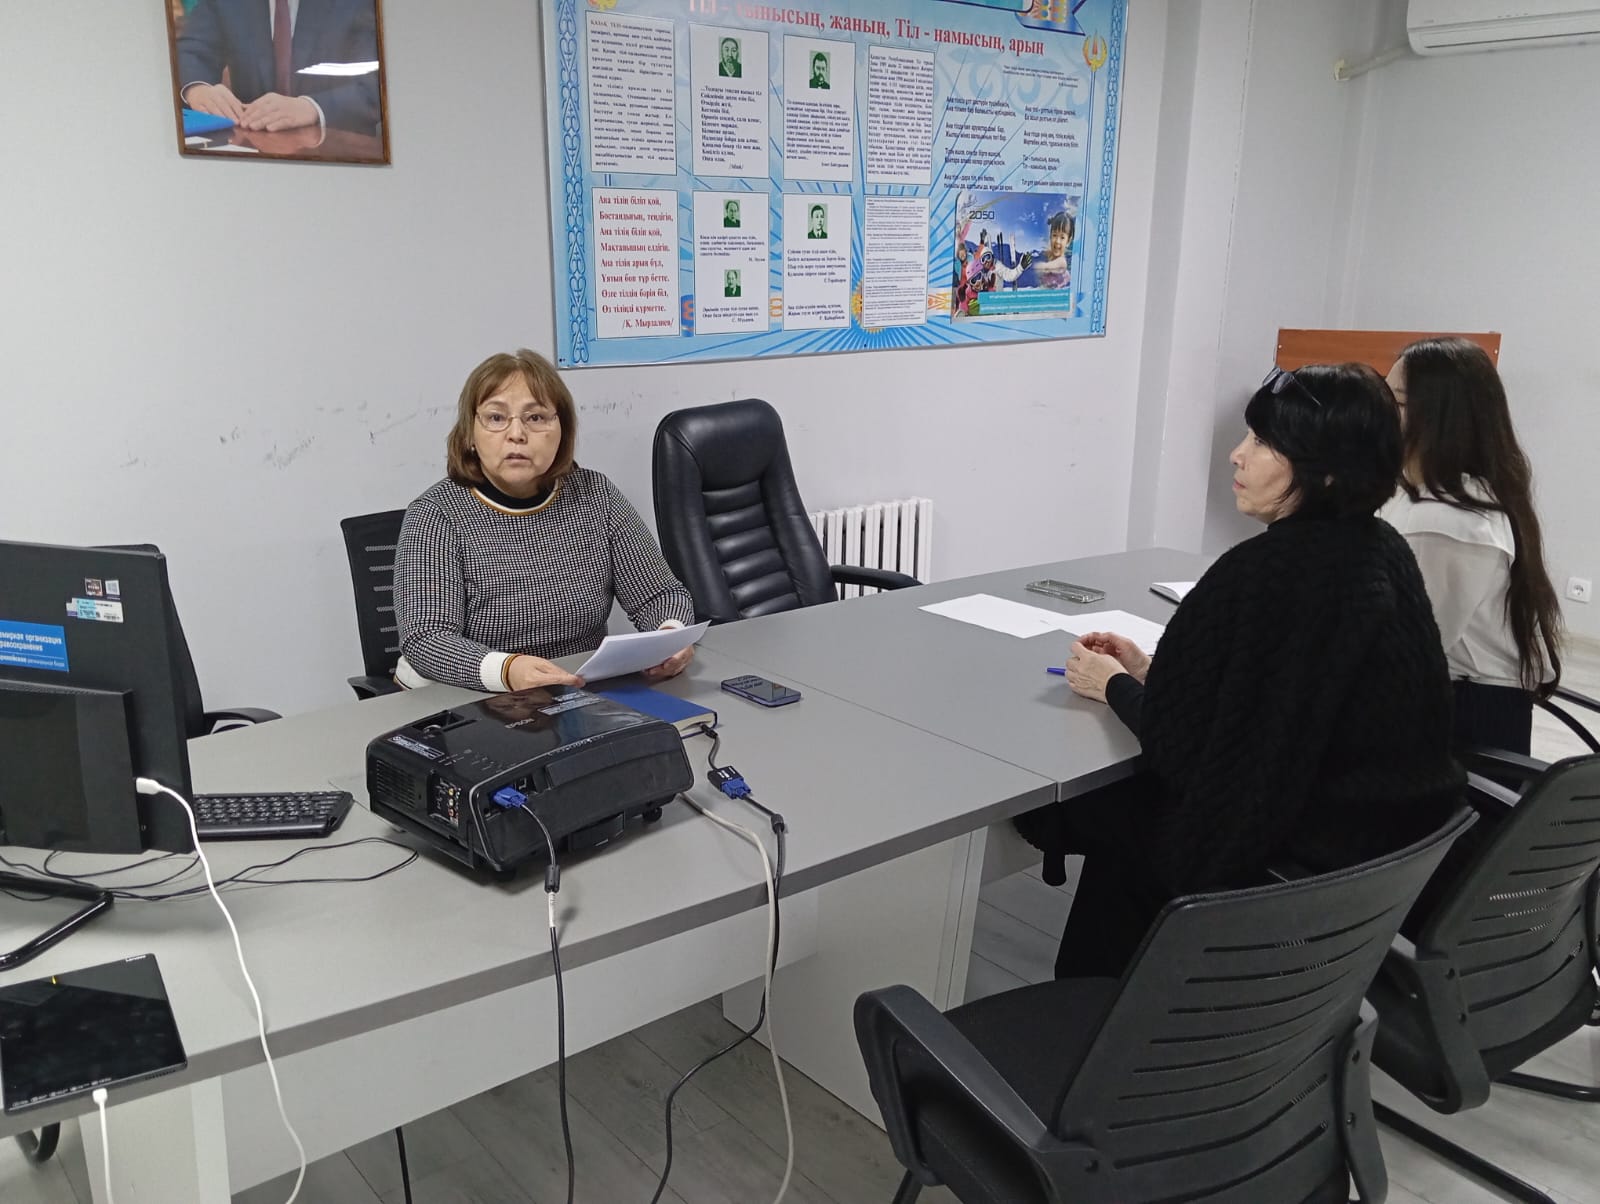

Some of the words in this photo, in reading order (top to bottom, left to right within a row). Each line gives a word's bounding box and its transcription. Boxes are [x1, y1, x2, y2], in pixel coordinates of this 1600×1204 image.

[830, 14, 890, 38] жаның,
[895, 18, 920, 40] Тіл
[934, 27, 1006, 53] намысың,
[1009, 36, 1044, 56] арың
[599, 196, 611, 204] Ана
[968, 210, 995, 220] 2050
[600, 227, 612, 236] Ана
[601, 258, 613, 267] Ана
